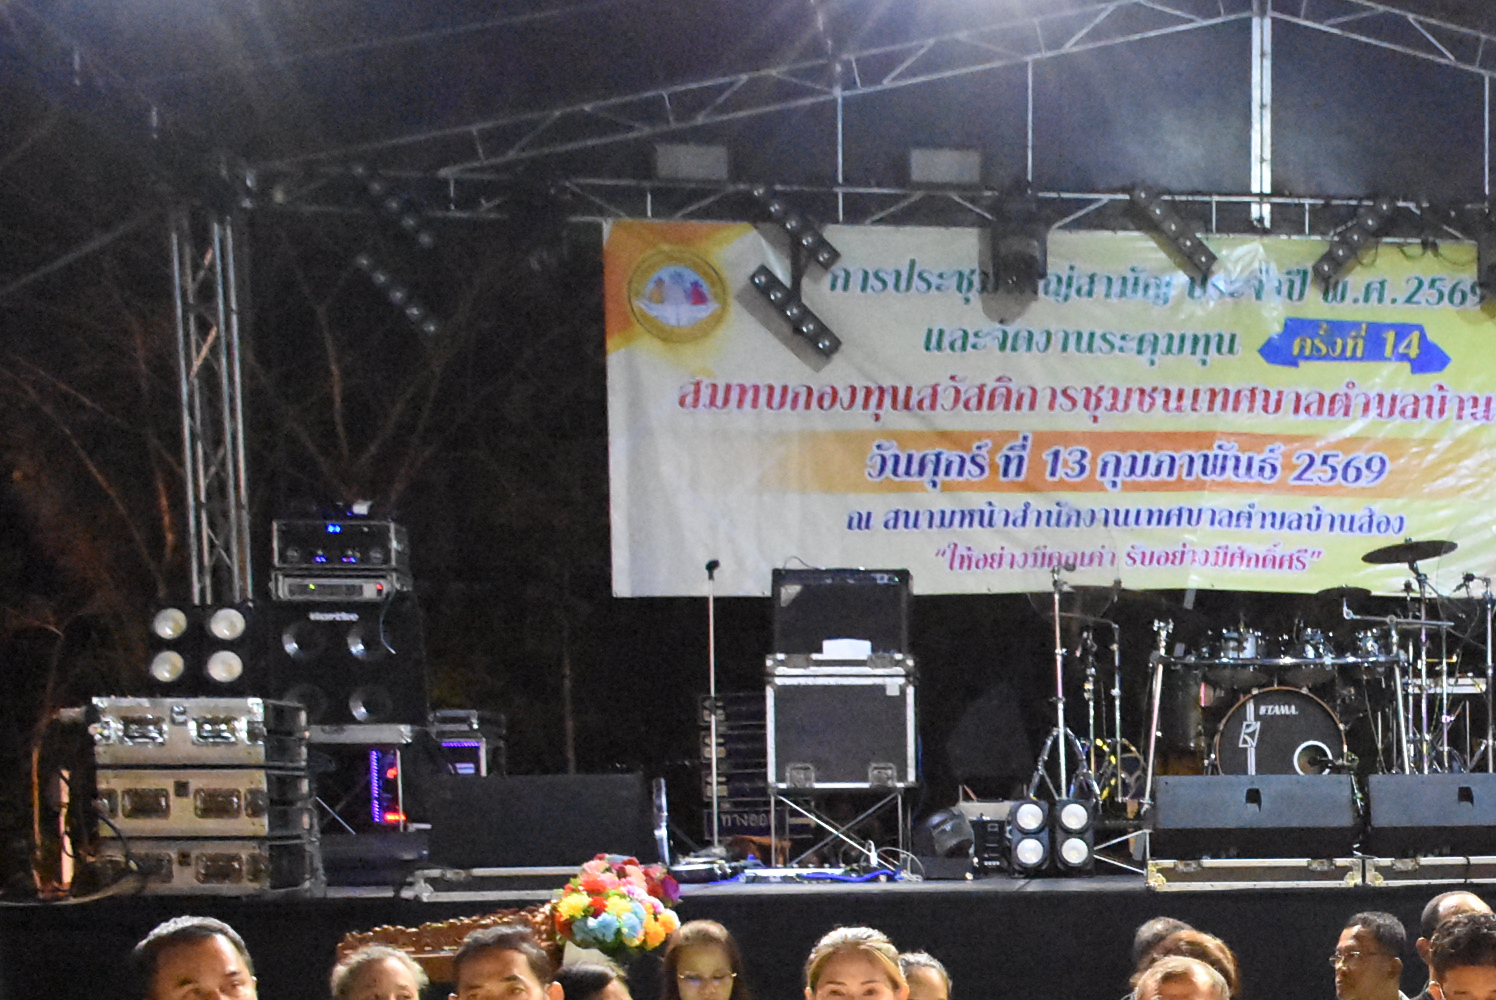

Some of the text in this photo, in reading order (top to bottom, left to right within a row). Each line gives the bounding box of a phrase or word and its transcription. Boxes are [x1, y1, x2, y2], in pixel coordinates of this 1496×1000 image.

[1292, 322, 1421, 360] ครั้งที่ 14
[868, 435, 1386, 489] วันศุกร์ ที่ 13 กุมภาพันธ์ 2569
[846, 509, 872, 530] ณ
[720, 813, 772, 827] ทางออ
